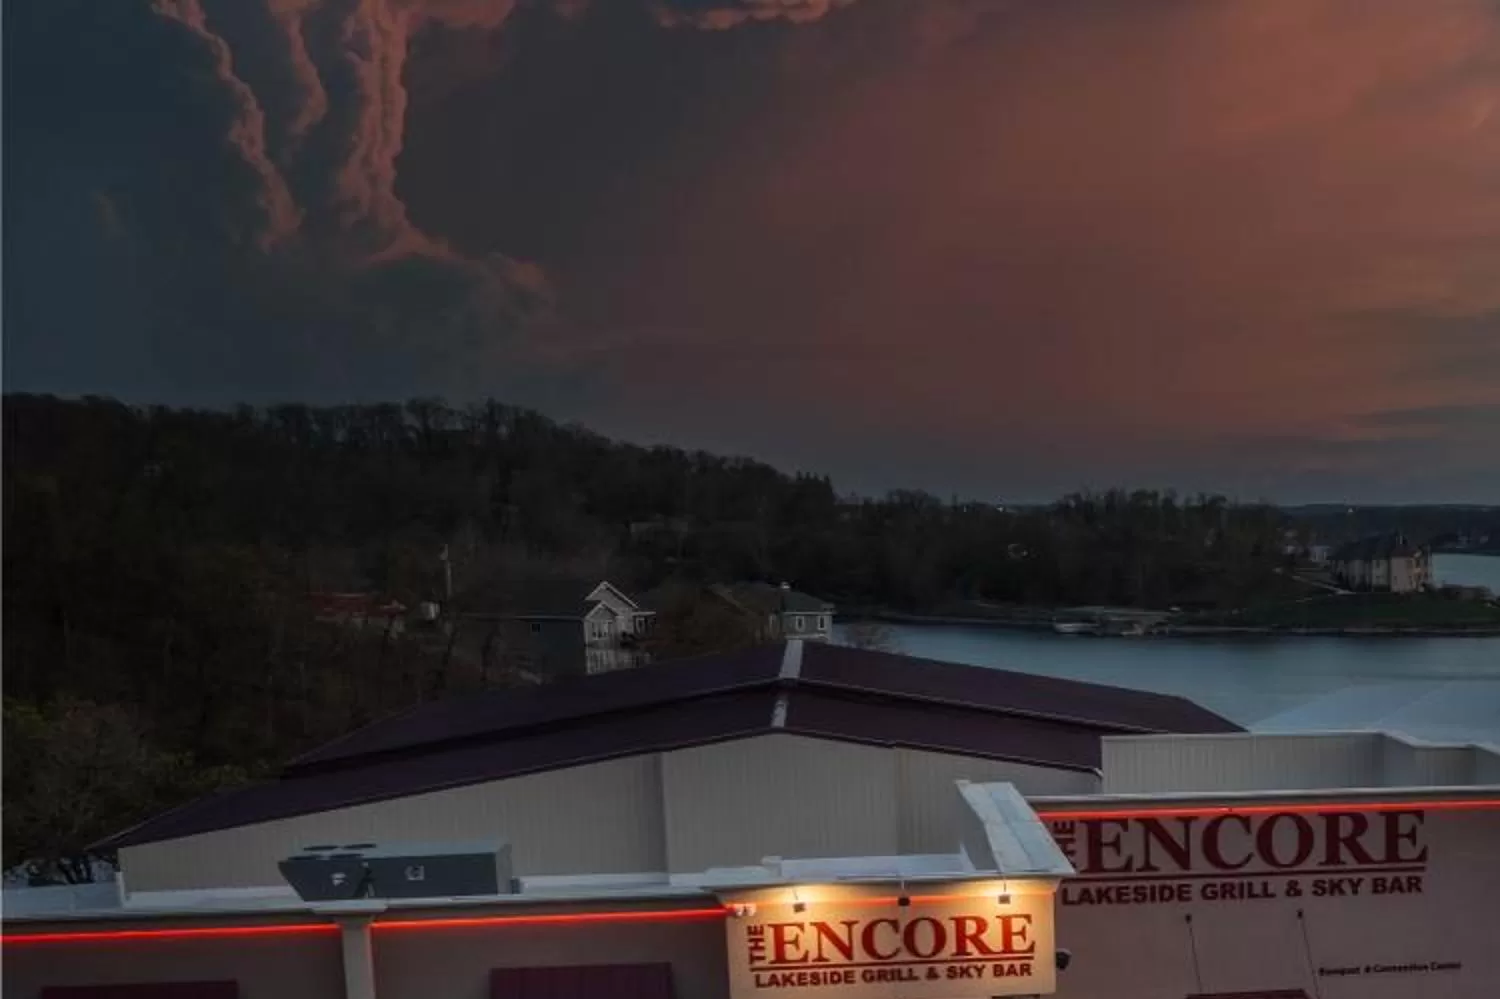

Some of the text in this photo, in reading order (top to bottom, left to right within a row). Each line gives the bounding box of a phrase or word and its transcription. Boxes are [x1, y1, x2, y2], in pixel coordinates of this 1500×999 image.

[1053, 820, 1077, 868] HE
[1080, 811, 1428, 874] ENCORE
[1061, 875, 1423, 905] LAKESIDE GRILL & SKY BAR
[746, 924, 766, 965] THE
[767, 914, 1036, 964] ENCORE
[755, 963, 1033, 988] LAKESIDE GRILL & SKY BAR
